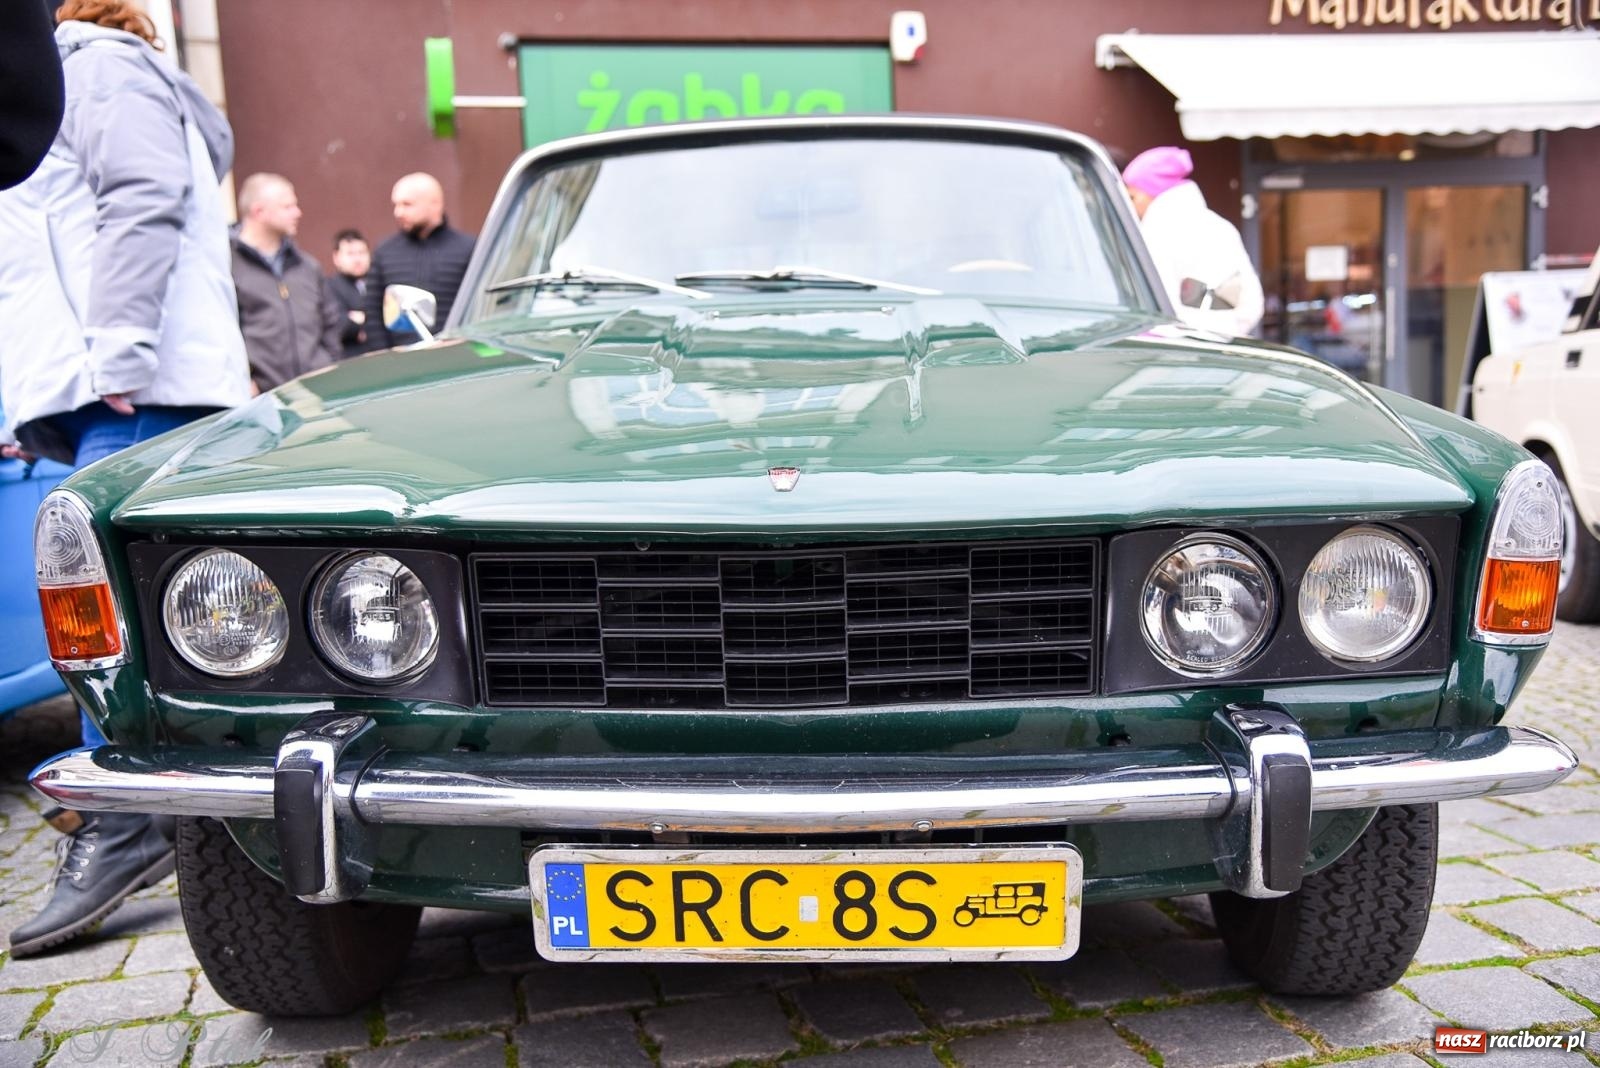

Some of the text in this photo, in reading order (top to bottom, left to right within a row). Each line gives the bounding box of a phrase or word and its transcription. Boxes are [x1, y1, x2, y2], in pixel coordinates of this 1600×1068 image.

[552, 916, 583, 936] PL
[605, 869, 938, 942] SRC 8S
